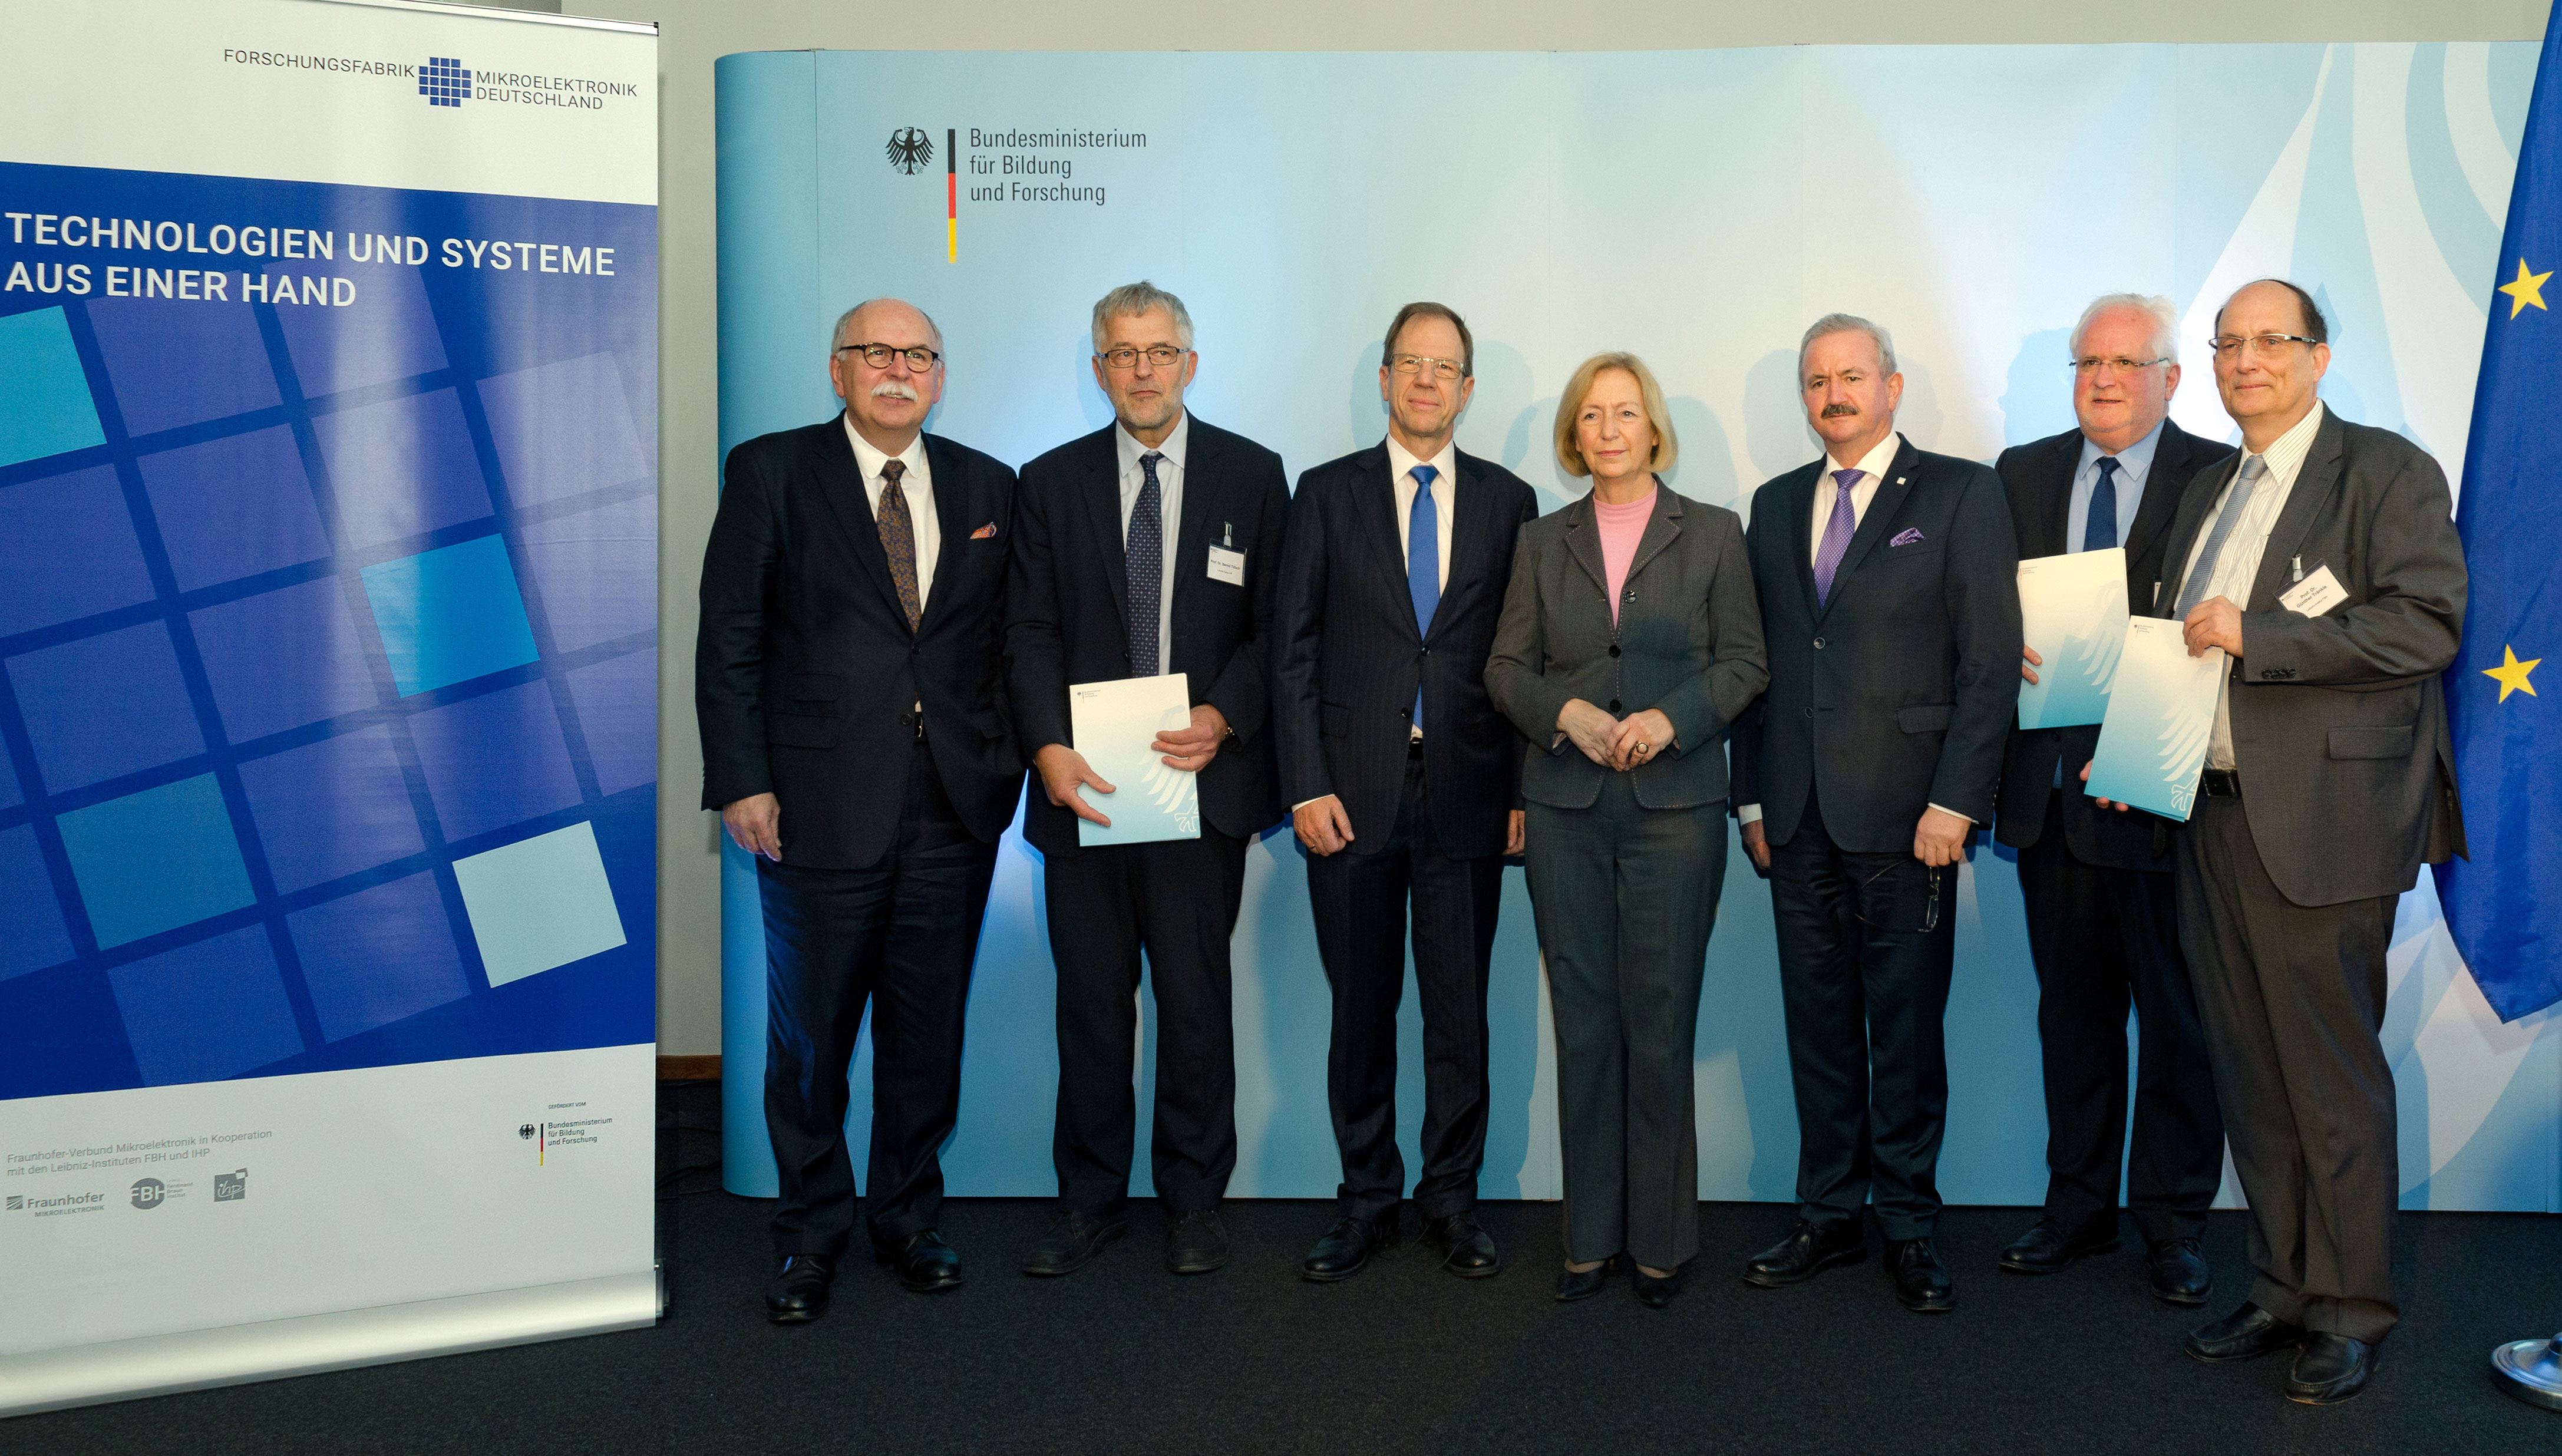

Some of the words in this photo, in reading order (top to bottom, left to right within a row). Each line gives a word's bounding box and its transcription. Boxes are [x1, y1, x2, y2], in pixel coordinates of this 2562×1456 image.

[224, 49, 415, 78] FORSCHUNGSFABRIK
[476, 70, 638, 97] MIKROELEKTRONIK
[476, 87, 603, 110] DEUTSCHLAND
[970, 128, 1147, 148] Bundesministerium
[969, 154, 995, 174] für
[1003, 155, 1071, 179] Bildung
[970, 182, 1004, 202] und
[1012, 182, 1105, 206] Forschung
[4, 212, 334, 260] TECHNOLOGIEN
[348, 233, 429, 267] UND
[441, 238, 616, 277] SYSTEME
[4, 261, 91, 296] AUS
[107, 266, 228, 303] EINER
[242, 273, 356, 308] HAND
[548, 1118, 613, 1128] Bundesministerium
[7, 1144, 113, 1163] Fraunhofer-Verbund
[116, 1135, 196, 1153] Mikroelektronik
[199, 1135, 208, 1144] in
[212, 1130, 272, 1144] Kooperation
[562, 1135, 597, 1145] Forschung
[7, 1167, 25, 1177] mit
[28, 1163, 48, 1175] den
[51, 1155, 141, 1173] Leibniz-Instituten
[145, 1153, 166, 1164] FBH
[169, 1150, 189, 1161] und
[192, 1148, 210, 1159] IHP
[27, 1192, 105, 1209] Fraunhofer
[34, 1205, 105, 1217] MIKROELEKTRONIK
